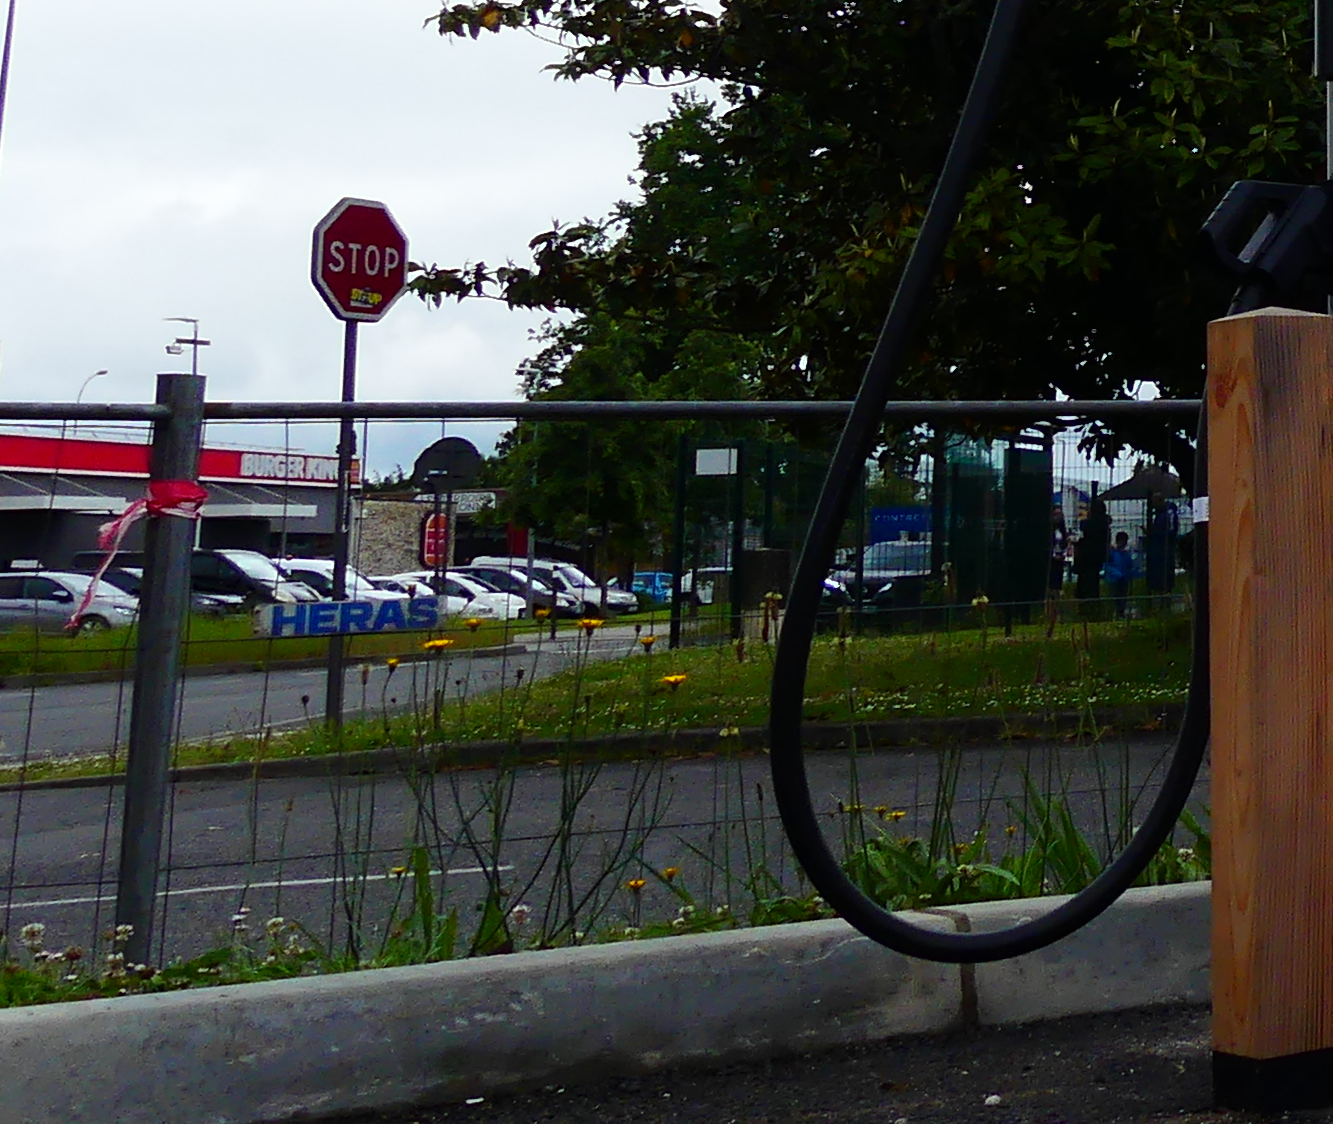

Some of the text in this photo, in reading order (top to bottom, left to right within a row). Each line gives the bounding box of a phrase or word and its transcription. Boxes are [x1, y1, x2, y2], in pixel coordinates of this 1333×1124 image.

[328, 240, 400, 278] STOP
[241, 452, 305, 479] BURGER
[305, 456, 339, 482] KIN
[271, 595, 440, 636] HERAS
